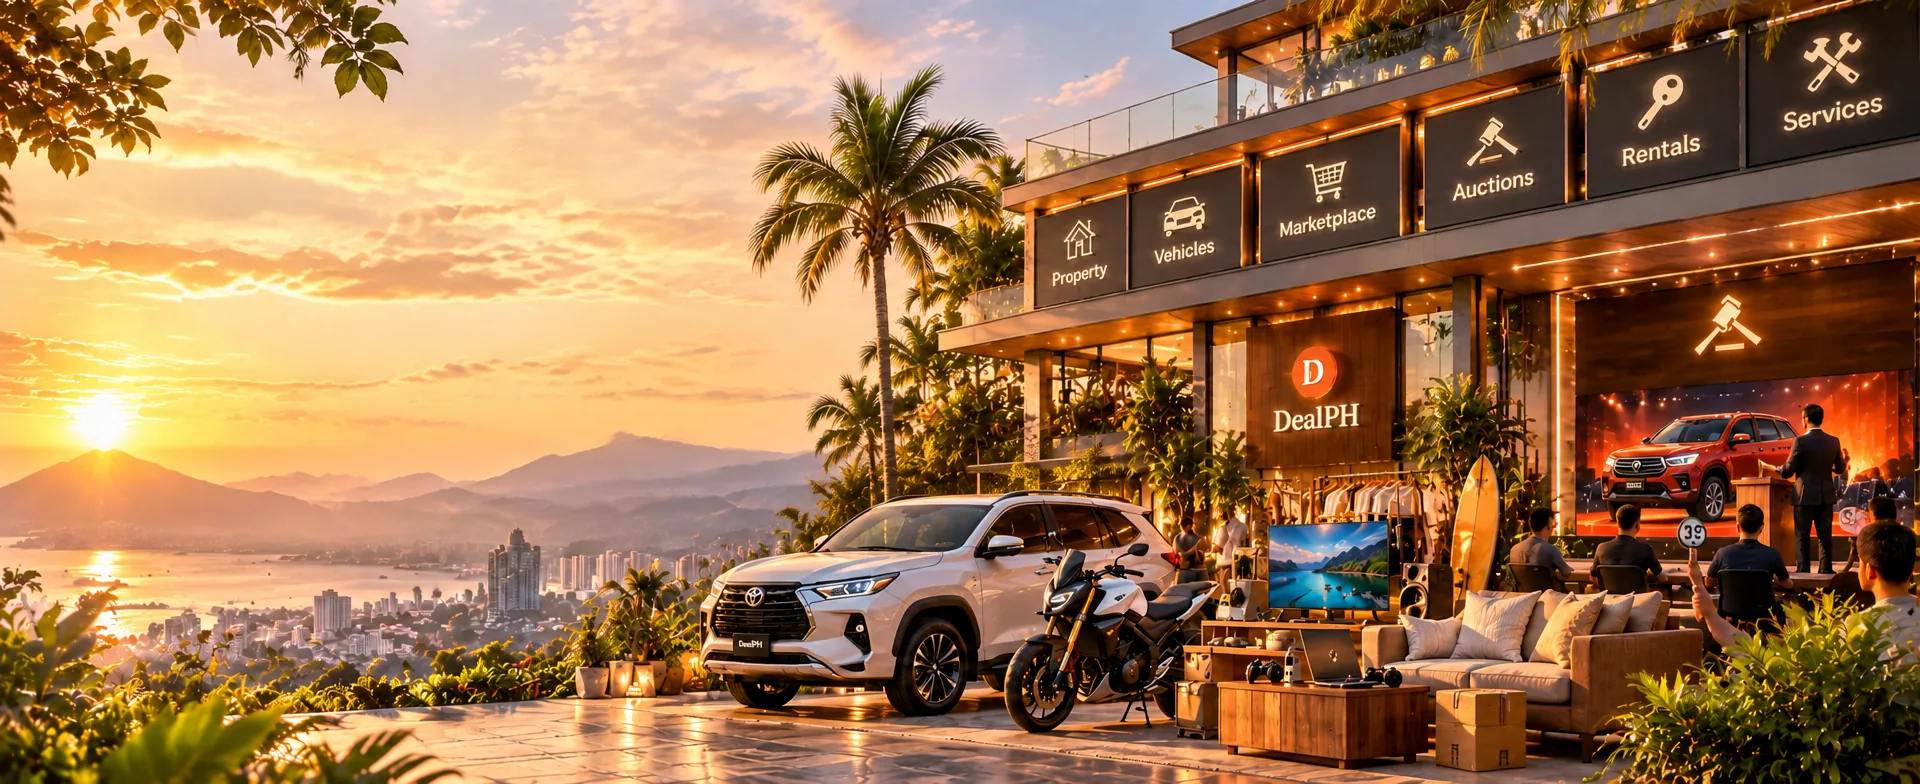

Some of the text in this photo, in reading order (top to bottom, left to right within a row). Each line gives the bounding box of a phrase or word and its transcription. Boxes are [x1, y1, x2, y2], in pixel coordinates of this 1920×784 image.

[1783, 97, 1883, 131] Services
[1622, 134, 1701, 167] Rentals
[1452, 169, 1534, 202] Auctions
[1279, 206, 1376, 238] Marketplace
[1154, 239, 1215, 265] Vehicles
[1052, 263, 1108, 287] Property
[1302, 359, 1324, 386] D
[1273, 403, 1360, 433] DealPH
[1684, 524, 1702, 540] 39
